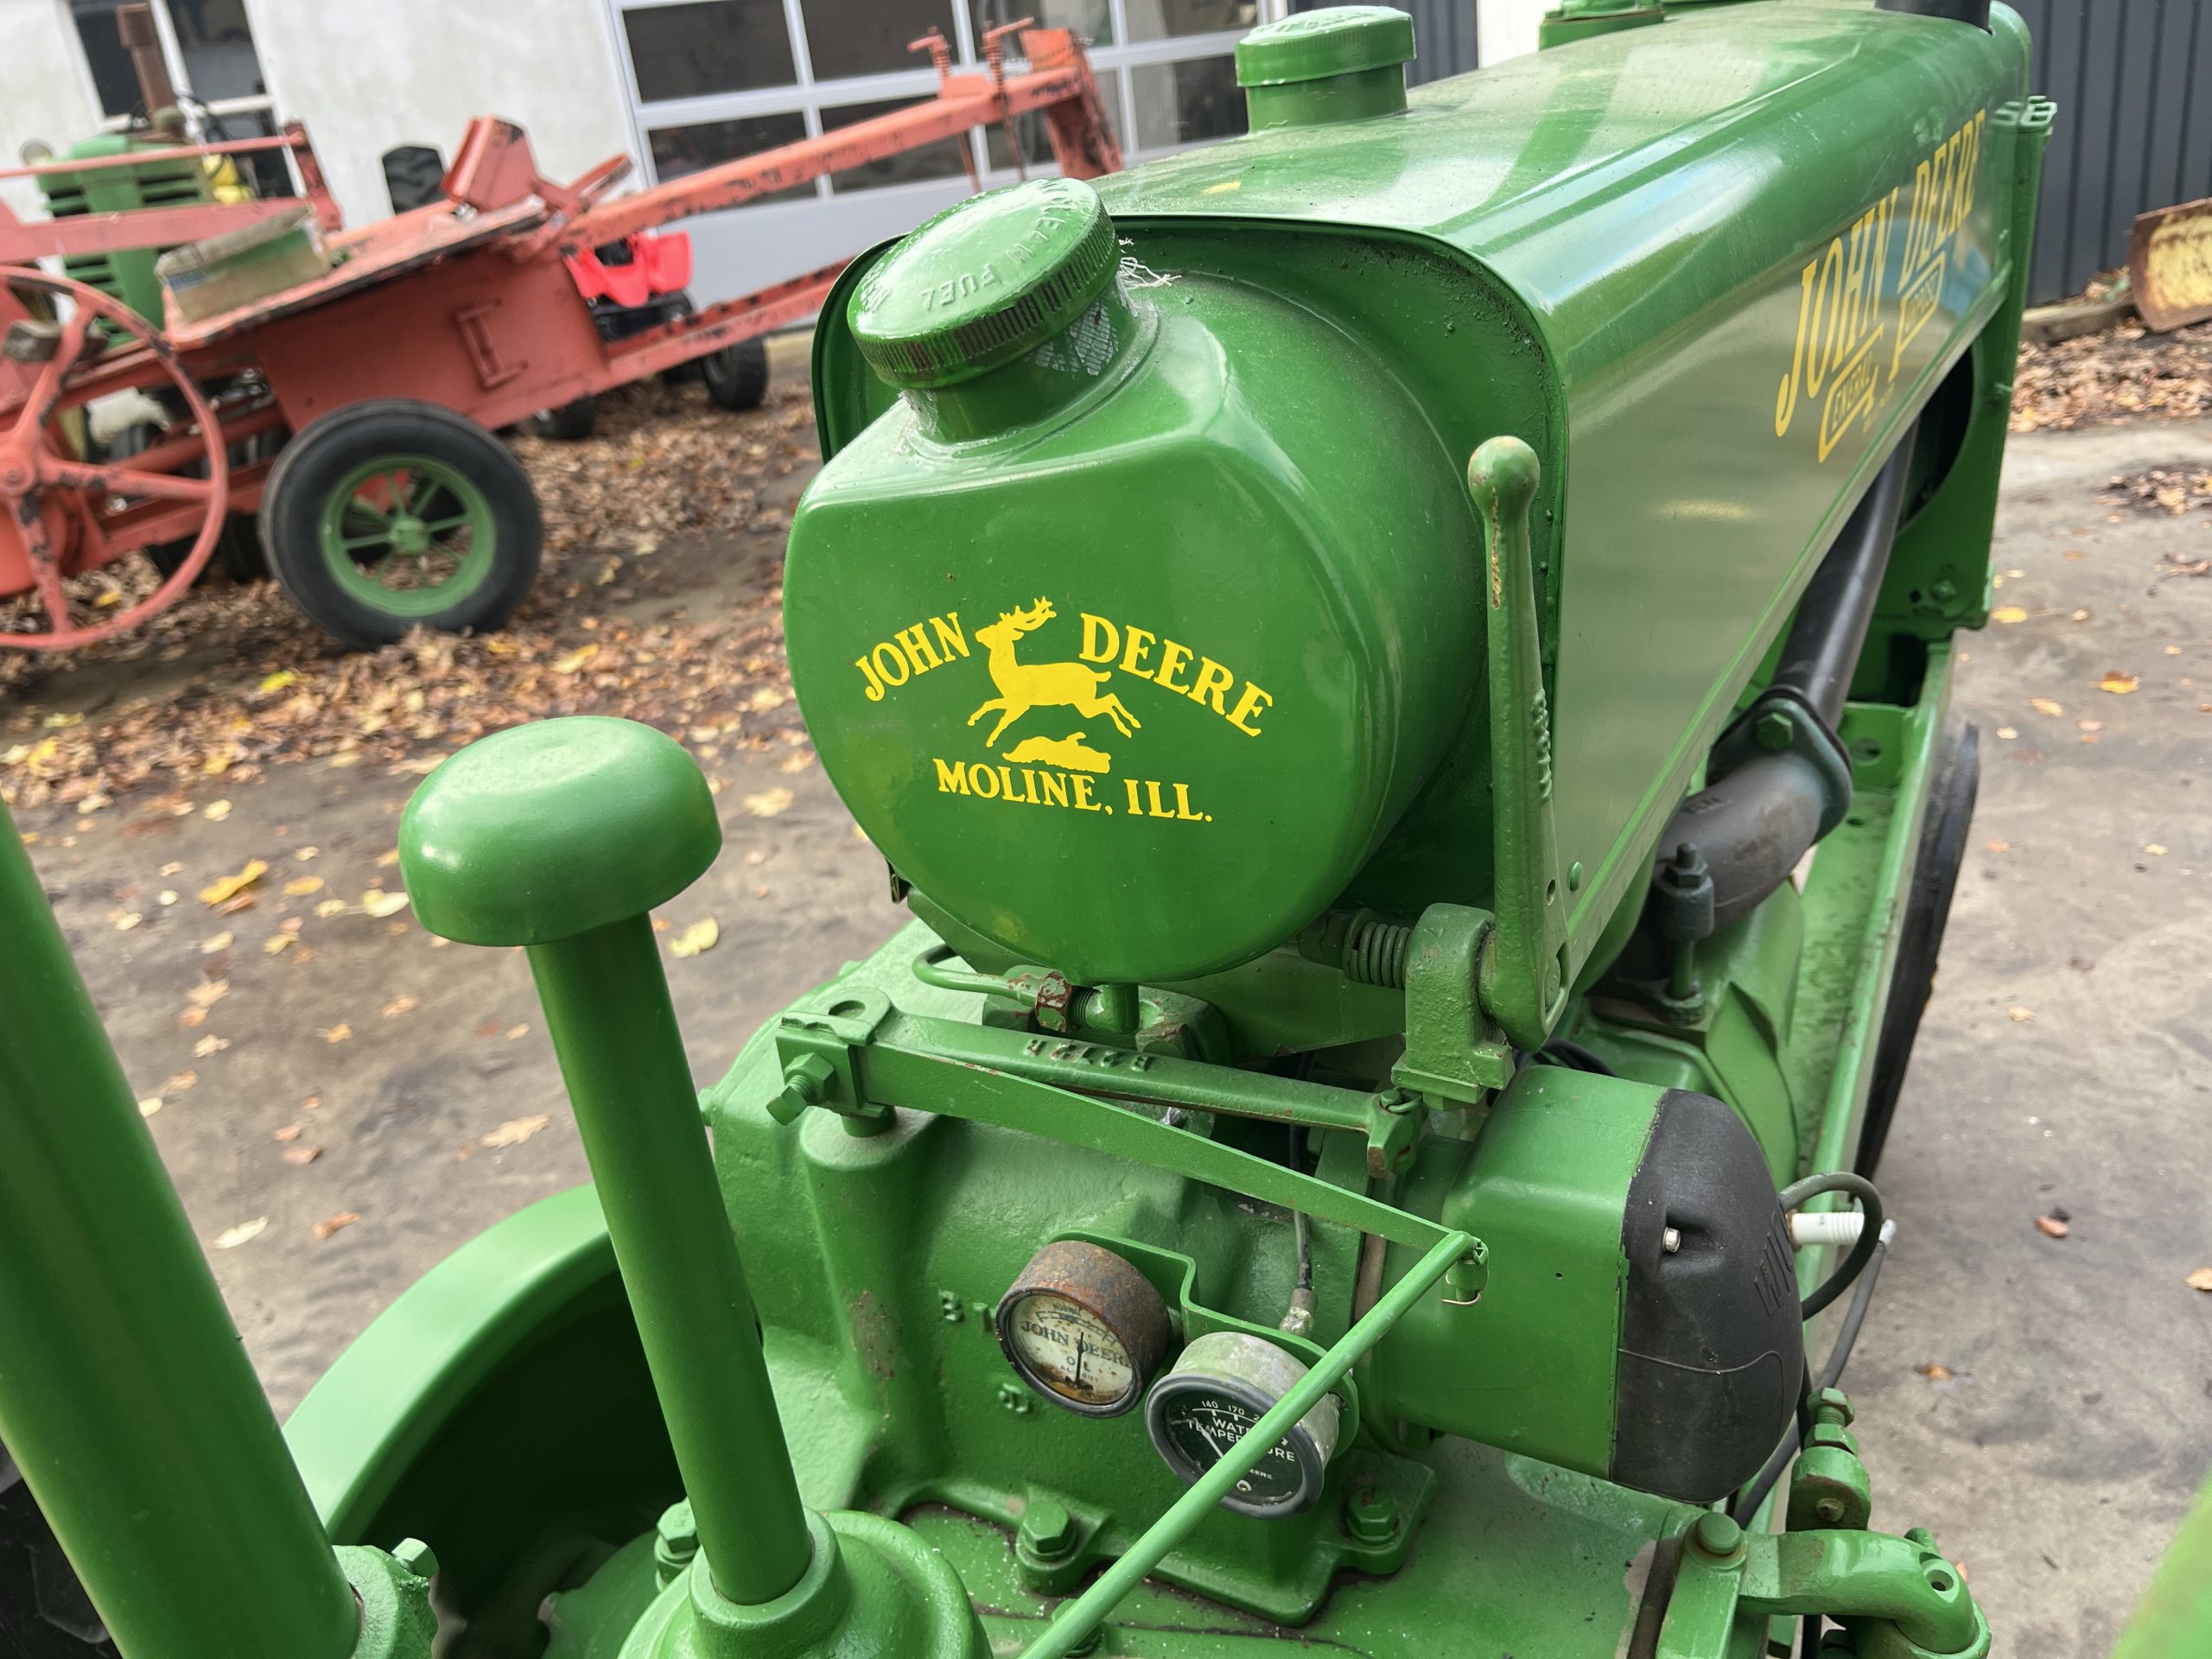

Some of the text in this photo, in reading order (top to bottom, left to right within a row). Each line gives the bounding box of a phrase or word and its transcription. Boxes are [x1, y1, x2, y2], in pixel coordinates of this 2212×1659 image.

[920, 262, 1002, 313] FUEL
[1775, 108, 1986, 437] JOHN DEERE
[855, 612, 1273, 737] JOHN DEERE
[1123, 779, 1212, 823] ILL.
[1020, 1320, 1133, 1369] JOHN DEER
[1065, 1355, 1091, 1372] OL
[1200, 1400, 1219, 1409] 140
[1227, 1404, 1245, 1415] 170
